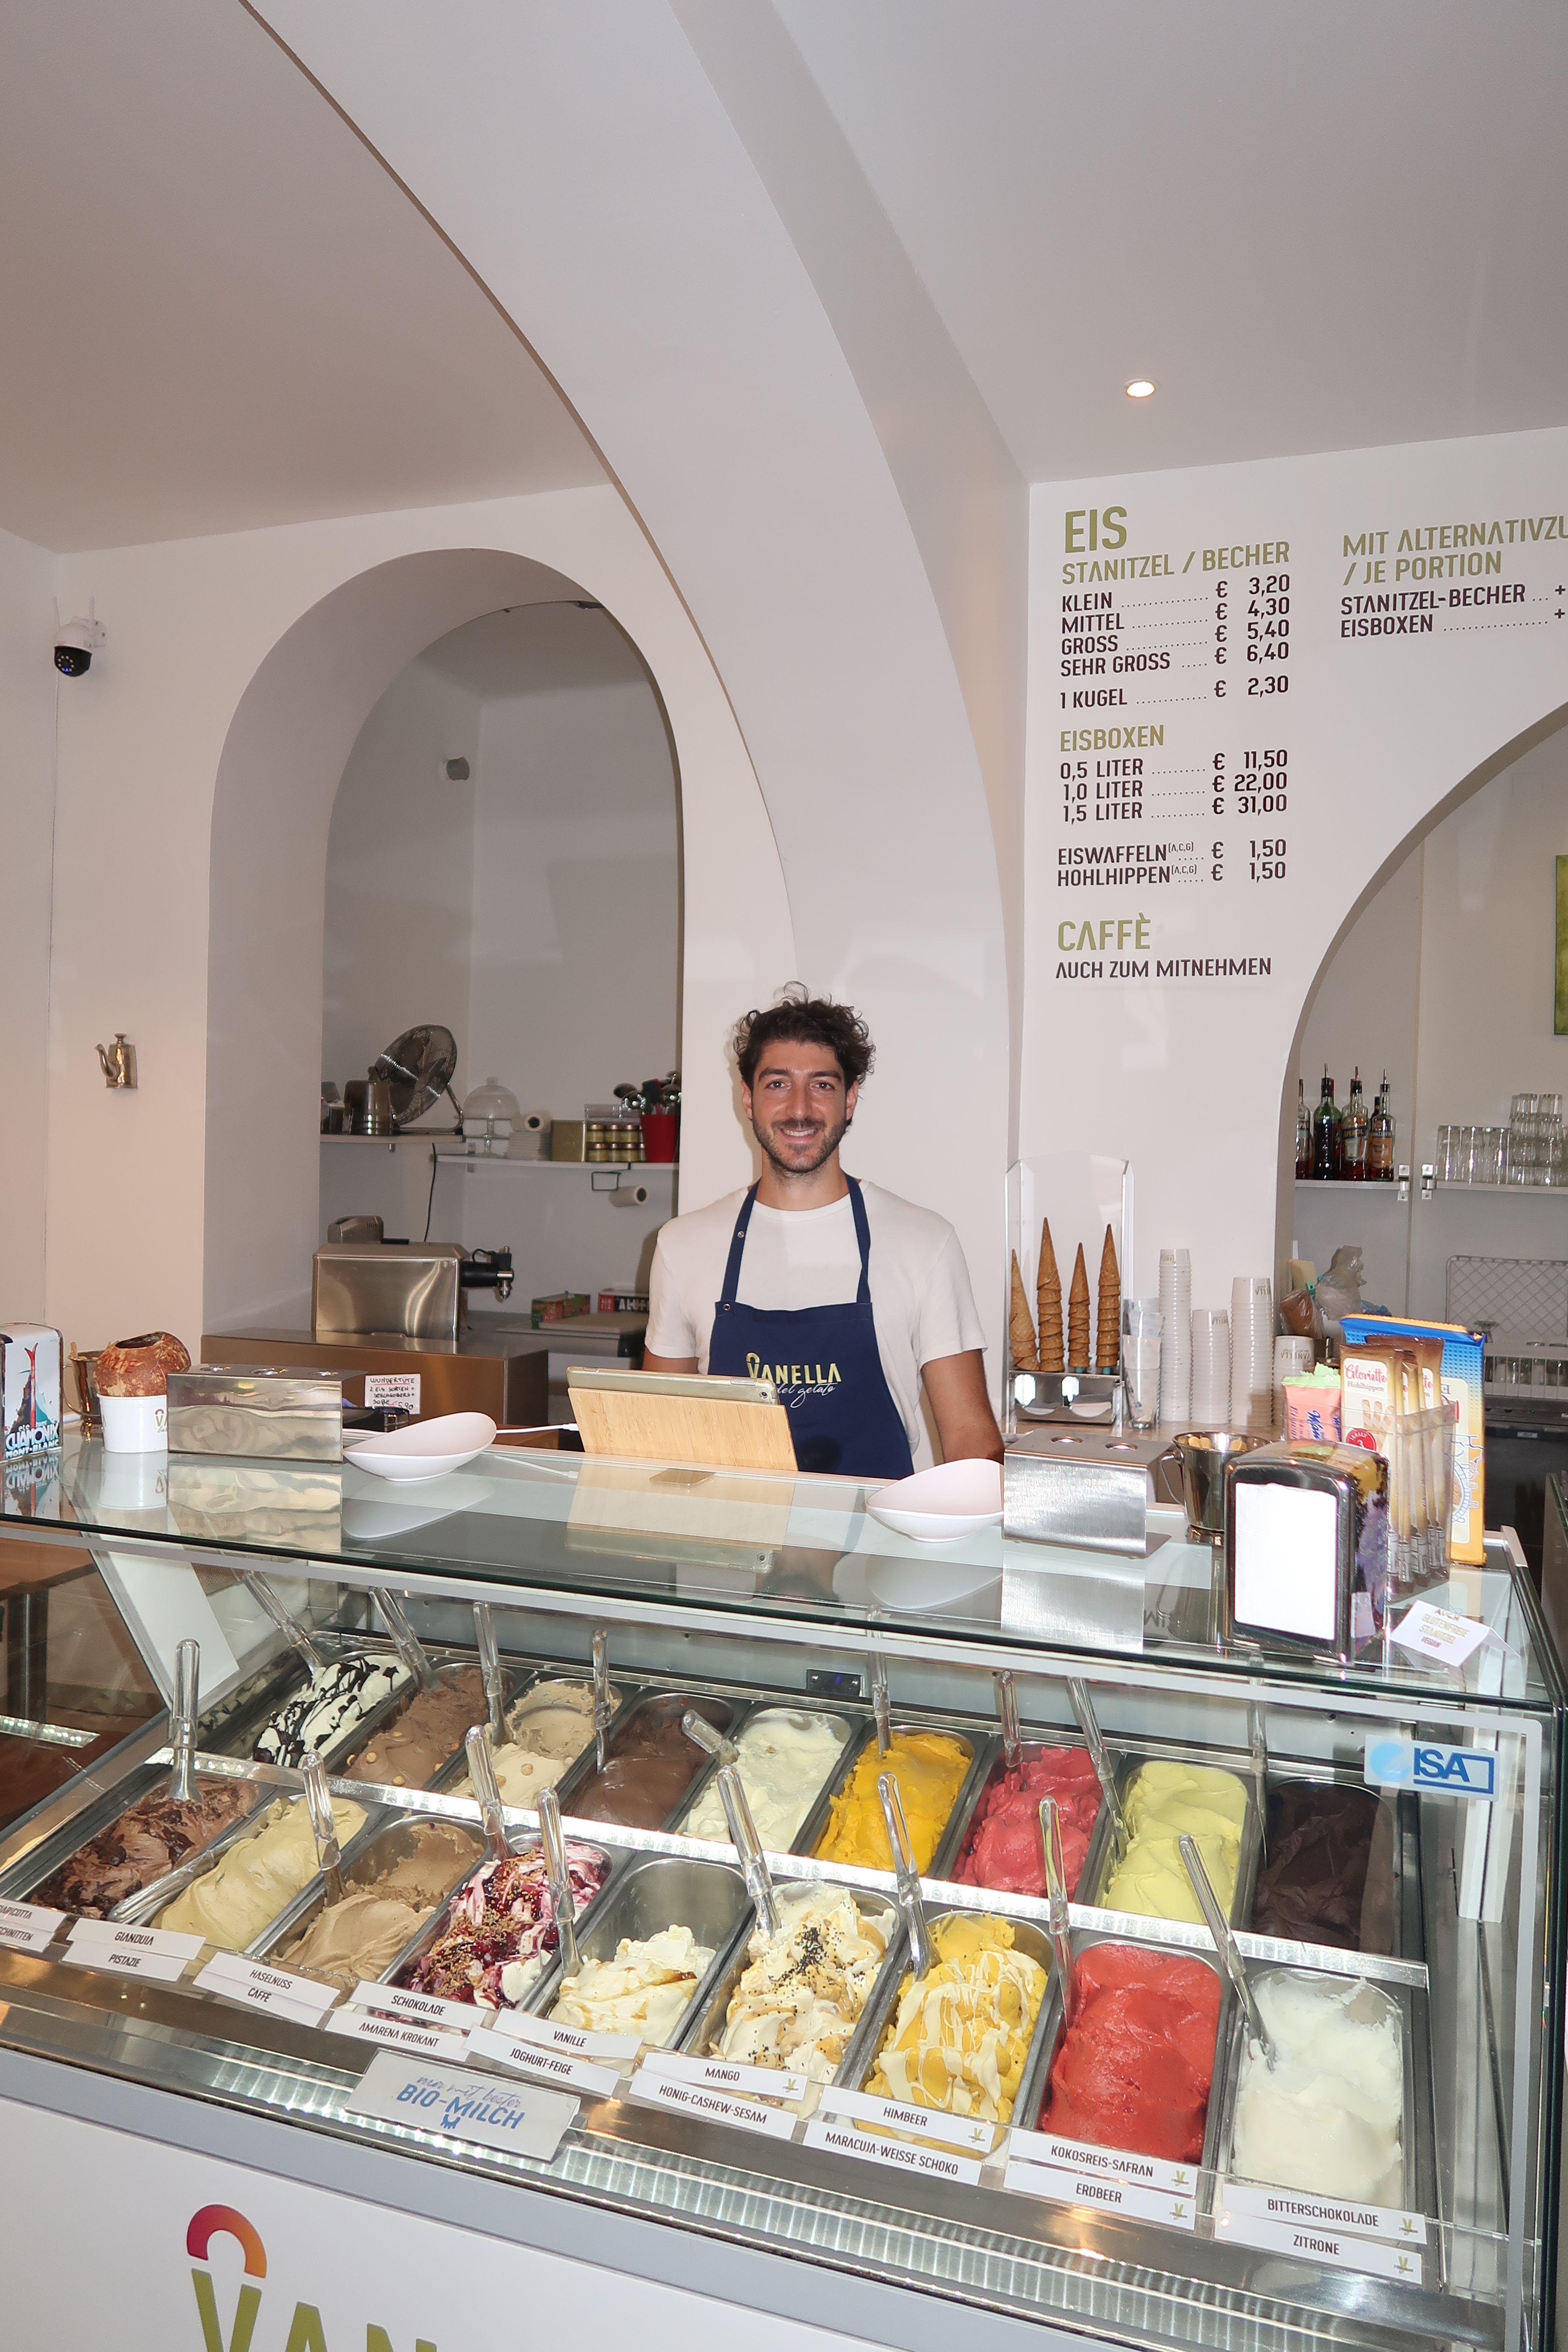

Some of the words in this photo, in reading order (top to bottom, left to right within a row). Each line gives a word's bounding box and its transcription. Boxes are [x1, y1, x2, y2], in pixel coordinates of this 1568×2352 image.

[1065, 506, 1127, 553] EIS
[1343, 531, 1389, 557] MIT
[1063, 554, 1174, 584] STANITZEL
[1182, 551, 1196, 573] /
[1203, 541, 1289, 571] BECHER
[1343, 562, 1357, 585] /
[1363, 560, 1386, 584] JE
[1395, 551, 1501, 582] PORTION
[1063, 592, 1112, 612] KLEIN
[1249, 574, 1289, 597] 3,20
[1341, 584, 1525, 615] STANITZEL-BECHER
[1062, 613, 1124, 634] MITTEL
[1247, 597, 1289, 619] 4,30
[1341, 614, 1433, 637] EISBOXEN
[1062, 635, 1118, 655] GROSS
[1248, 619, 1289, 642] 5,40
[1061, 658, 1106, 677] SEHR
[1113, 652, 1170, 674] GROSS
[1247, 641, 1289, 665] 6,40
[1060, 692, 1066, 709] 1
[1073, 688, 1127, 708] KUGEL
[1248, 675, 1288, 698] 2,30
[1061, 724, 1164, 752] EISBOXEN
[1060, 762, 1087, 782] 0,5
[1097, 758, 1143, 777] LITER
[1244, 749, 1287, 772] 11,50
[1064, 783, 1087, 803] 1,0
[1096, 780, 1142, 799] LITER
[1234, 772, 1287, 794] 22,00
[1063, 805, 1087, 825] 1,5
[1096, 802, 1142, 821] LITER
[1238, 794, 1286, 816] 31,00
[1250, 839, 1286, 861] 1,50
[1250, 861, 1286, 883] 1,50
[1058, 913, 1151, 951] CAFFÈ
[1056, 961, 1103, 978] AUCH
[1109, 960, 1148, 978] ZUM
[1157, 957, 1271, 977] MITNEHMEN
[746, 1353, 842, 1384] VANELLA
[1344, 1364, 1387, 1383] Gloriette
[790, 1382, 838, 1408] gelato
[1347, 1381, 1384, 1392] Hohlhippen
[1413, 1746, 1470, 1783] ISA
[114, 1931, 154, 1945] GIANDUIA
[108, 1954, 141, 1967] PISTAZIE
[249, 1969, 293, 1989] HASELNUSS
[391, 1995, 446, 2016] SCHOKOLADE
[358, 2022, 400, 2039] AMARENA
[400, 2030, 440, 2048] KROKANT
[553, 2030, 587, 2047] VANILLE
[509, 2047, 573, 2075] JOGHURT-FEIGE
[705, 2067, 740, 2081] MANGO
[396, 2083, 525, 2129] BIO-MILCH
[658, 2084, 767, 2124] HONIG-CASHEW-SESAM
[883, 2106, 928, 2127] HIMBEER
[825, 2132, 917, 2165] MARACUJA-WEISSE
[918, 2155, 959, 2175] SCHOKO
[1050, 2144, 1154, 2177] KOKOSREIS-SAFRAN
[1076, 2182, 1122, 2204] ERDBEER
[1268, 2198, 1379, 2227] BITTERSCHOKOLADE
[1293, 2233, 1340, 2255] ZITRONE
